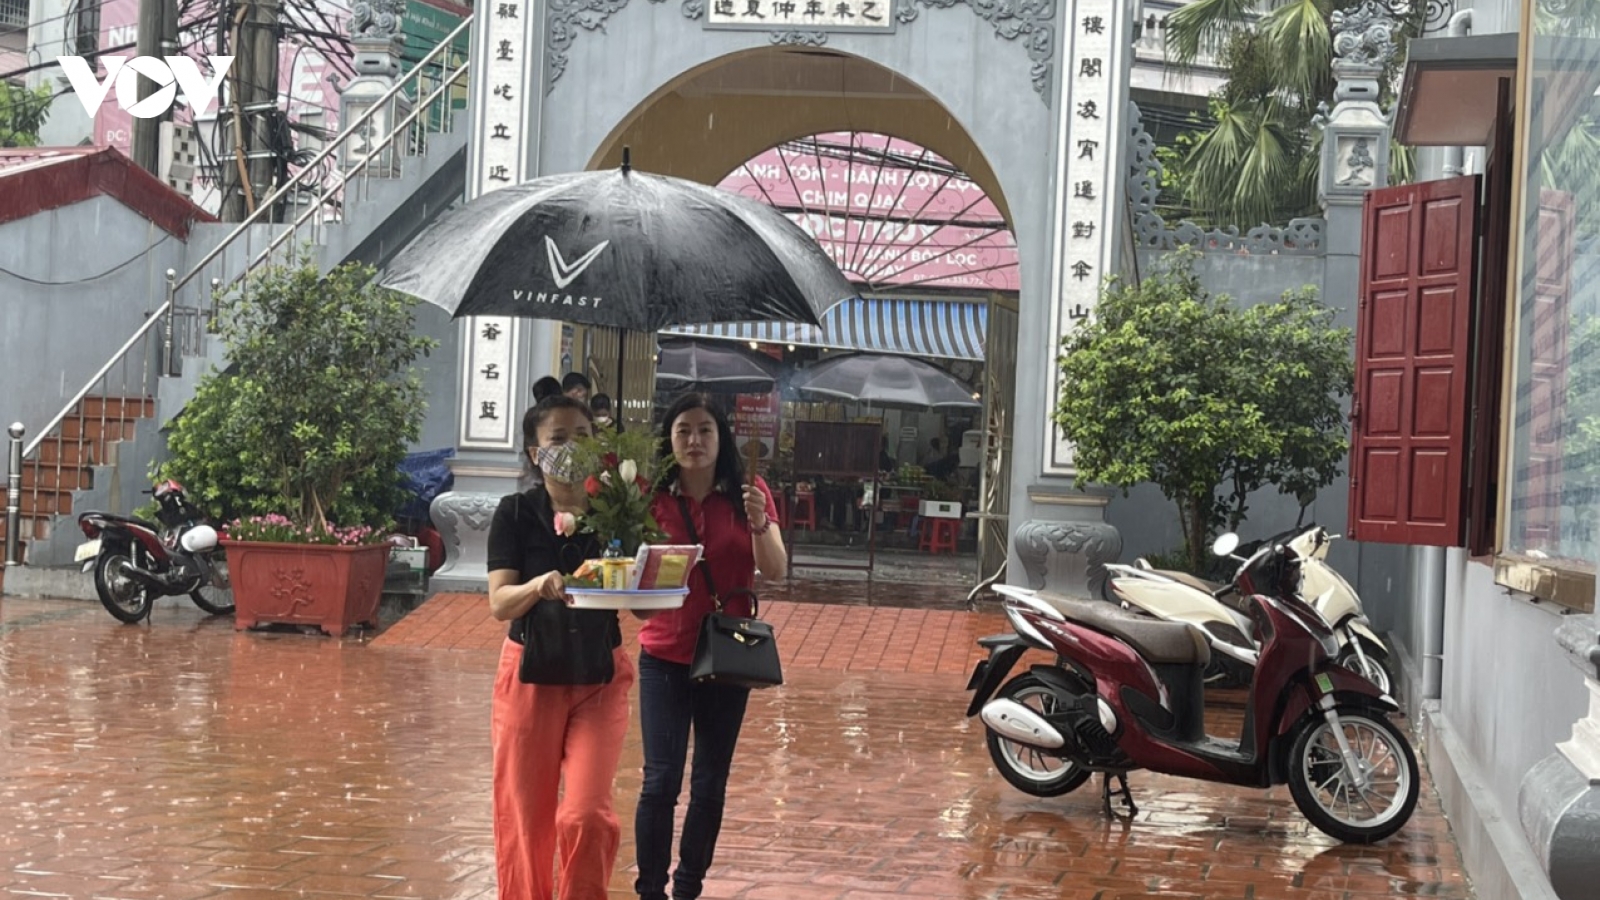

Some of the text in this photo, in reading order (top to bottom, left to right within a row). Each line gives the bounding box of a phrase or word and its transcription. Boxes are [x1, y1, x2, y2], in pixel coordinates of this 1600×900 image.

[802, 189, 907, 209] CHIM QUAY
[512, 289, 605, 309] VINFAST
